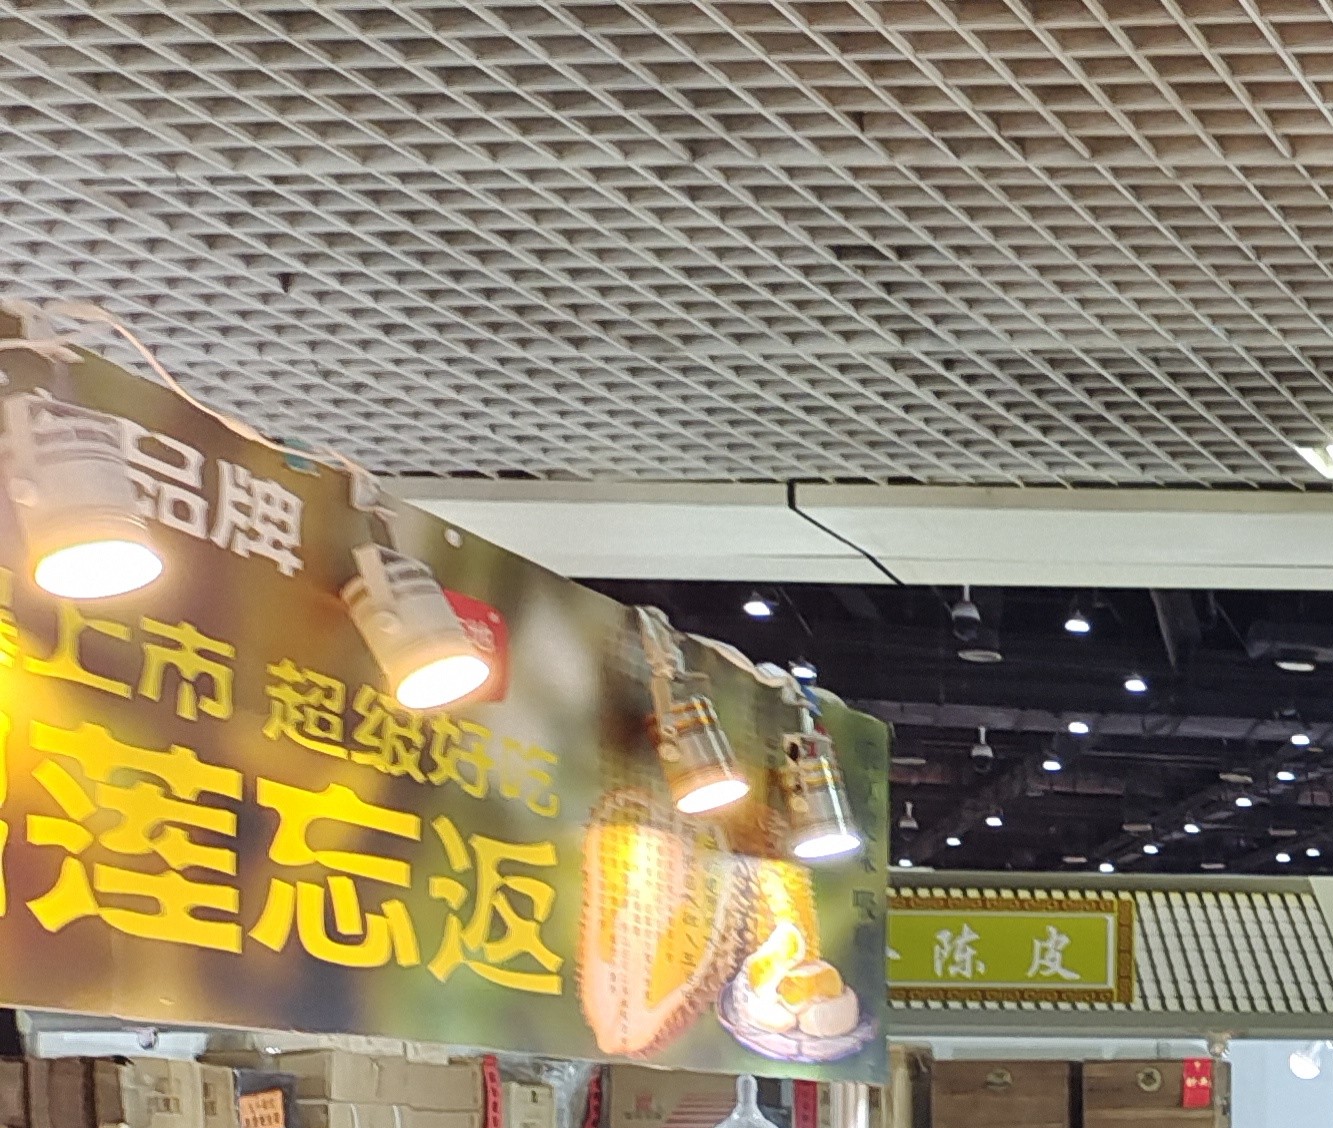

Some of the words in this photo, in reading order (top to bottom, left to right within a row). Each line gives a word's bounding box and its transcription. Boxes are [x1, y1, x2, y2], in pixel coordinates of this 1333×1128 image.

[263, 657, 560, 818] 超级好吃
[0, 716, 564, 995] 莲忘返
[888, 923, 1081, 981] 陈皮
